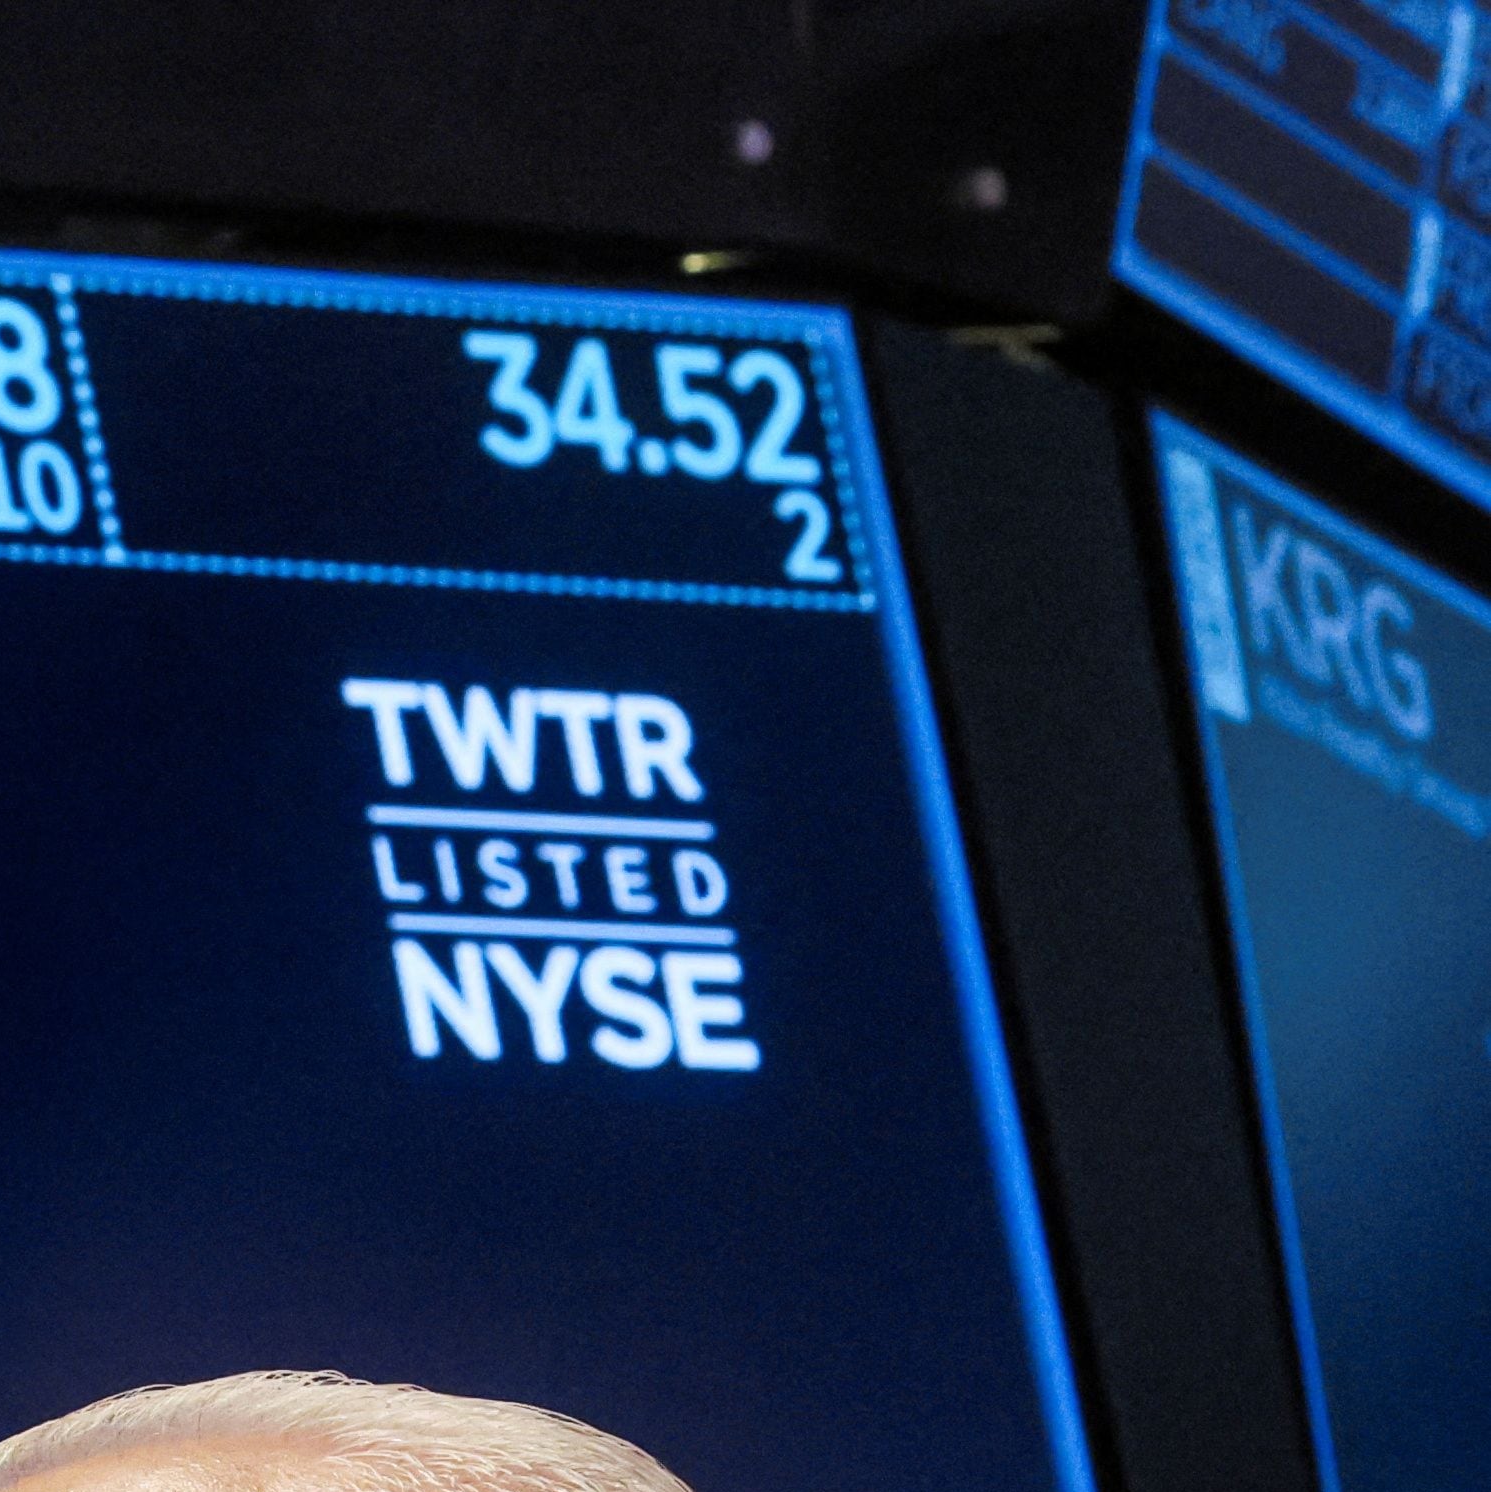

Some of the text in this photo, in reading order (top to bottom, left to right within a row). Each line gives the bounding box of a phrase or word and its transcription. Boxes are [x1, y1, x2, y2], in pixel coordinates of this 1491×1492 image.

[461, 328, 823, 486] 34.52
[772, 488, 844, 583] 2
[1231, 503, 1435, 742] KRG
[340, 677, 706, 802] TWTR
[371, 834, 730, 918] LISTED
[391, 937, 764, 1073] NYSE
